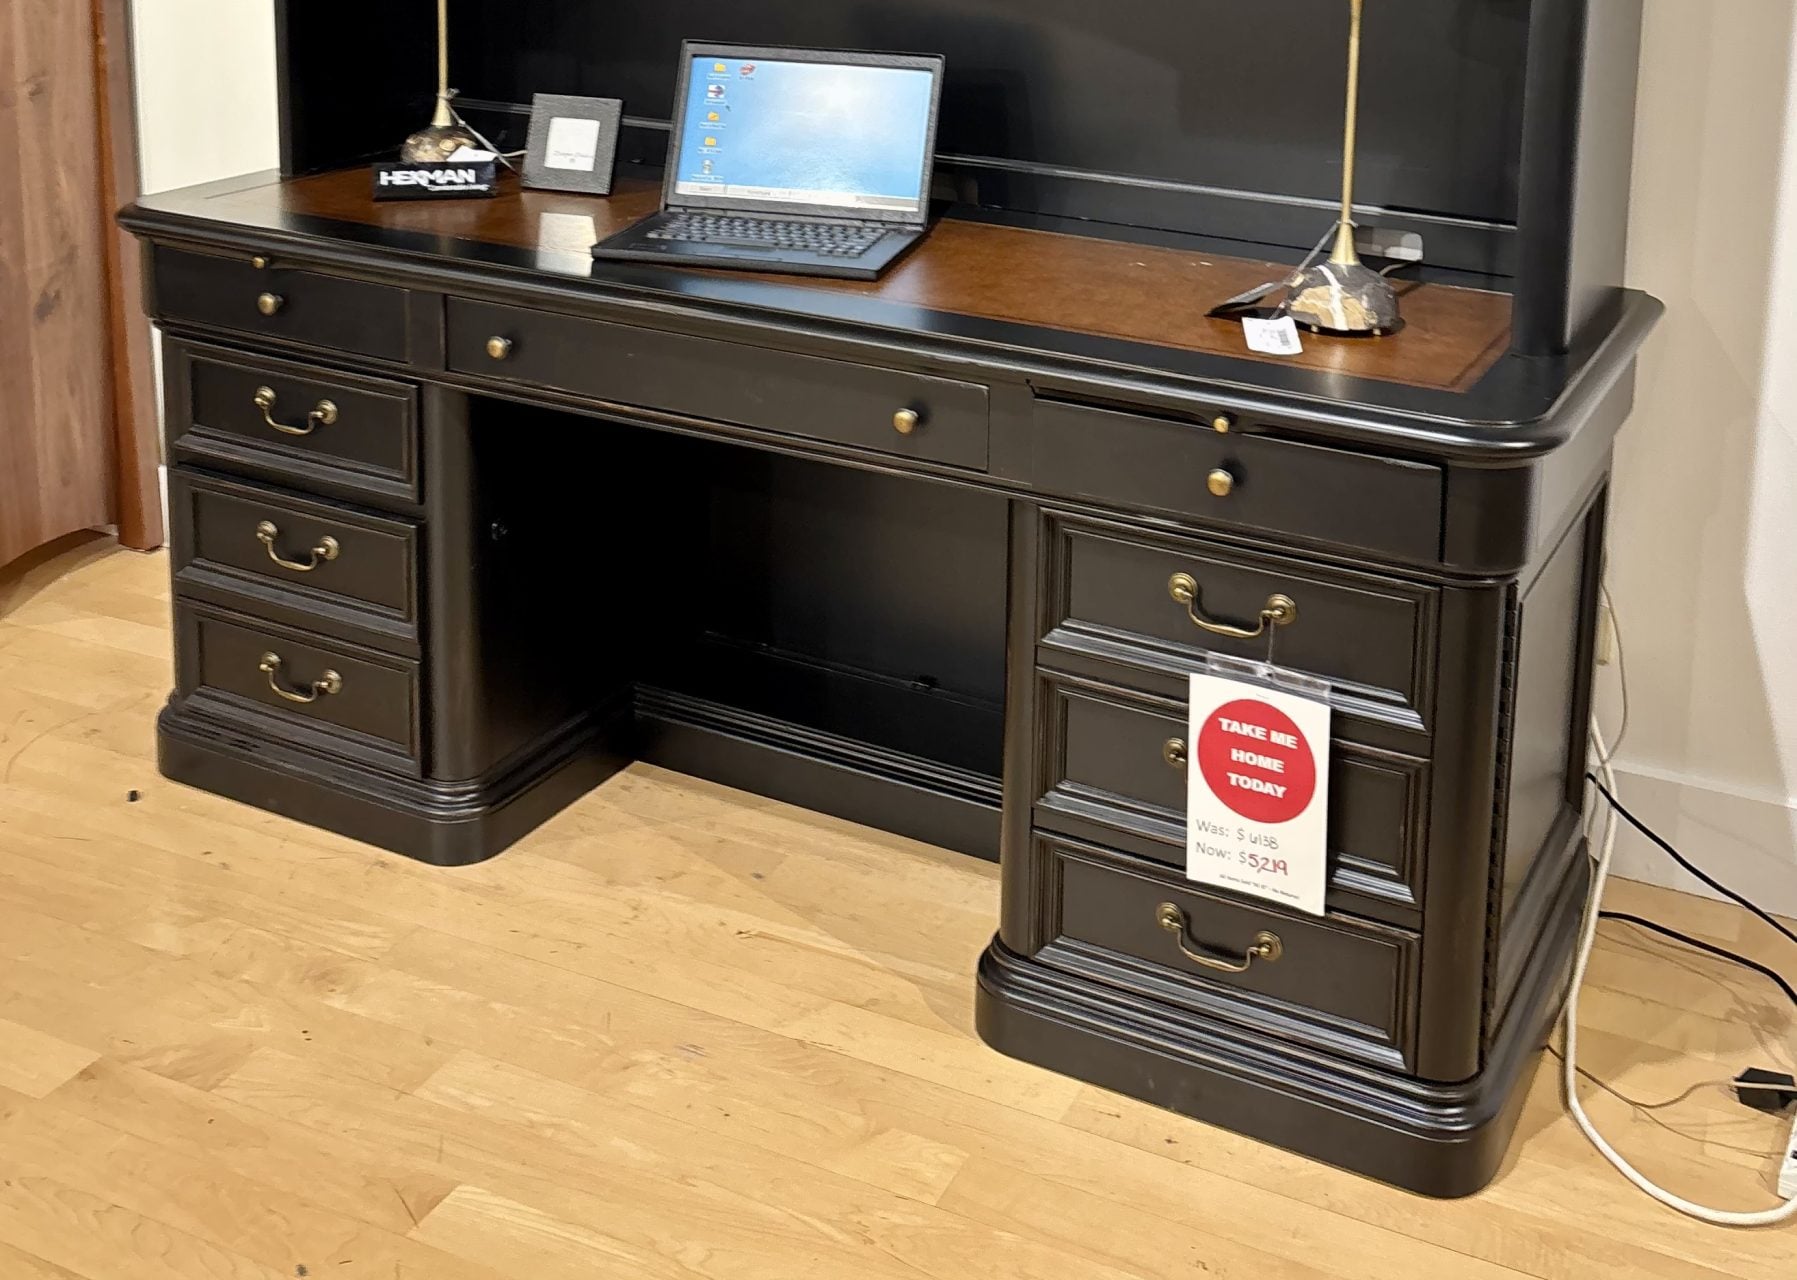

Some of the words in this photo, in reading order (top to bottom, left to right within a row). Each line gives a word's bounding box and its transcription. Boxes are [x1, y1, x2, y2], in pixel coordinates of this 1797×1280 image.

[1217, 717, 1267, 741] TAKE
[1269, 729, 1298, 750] ME
[1230, 747, 1285, 773] HOME
[1226, 771, 1288, 799] TODAY
[1196, 819, 1230, 837] Was:
[1196, 841, 1232, 861] Now:
